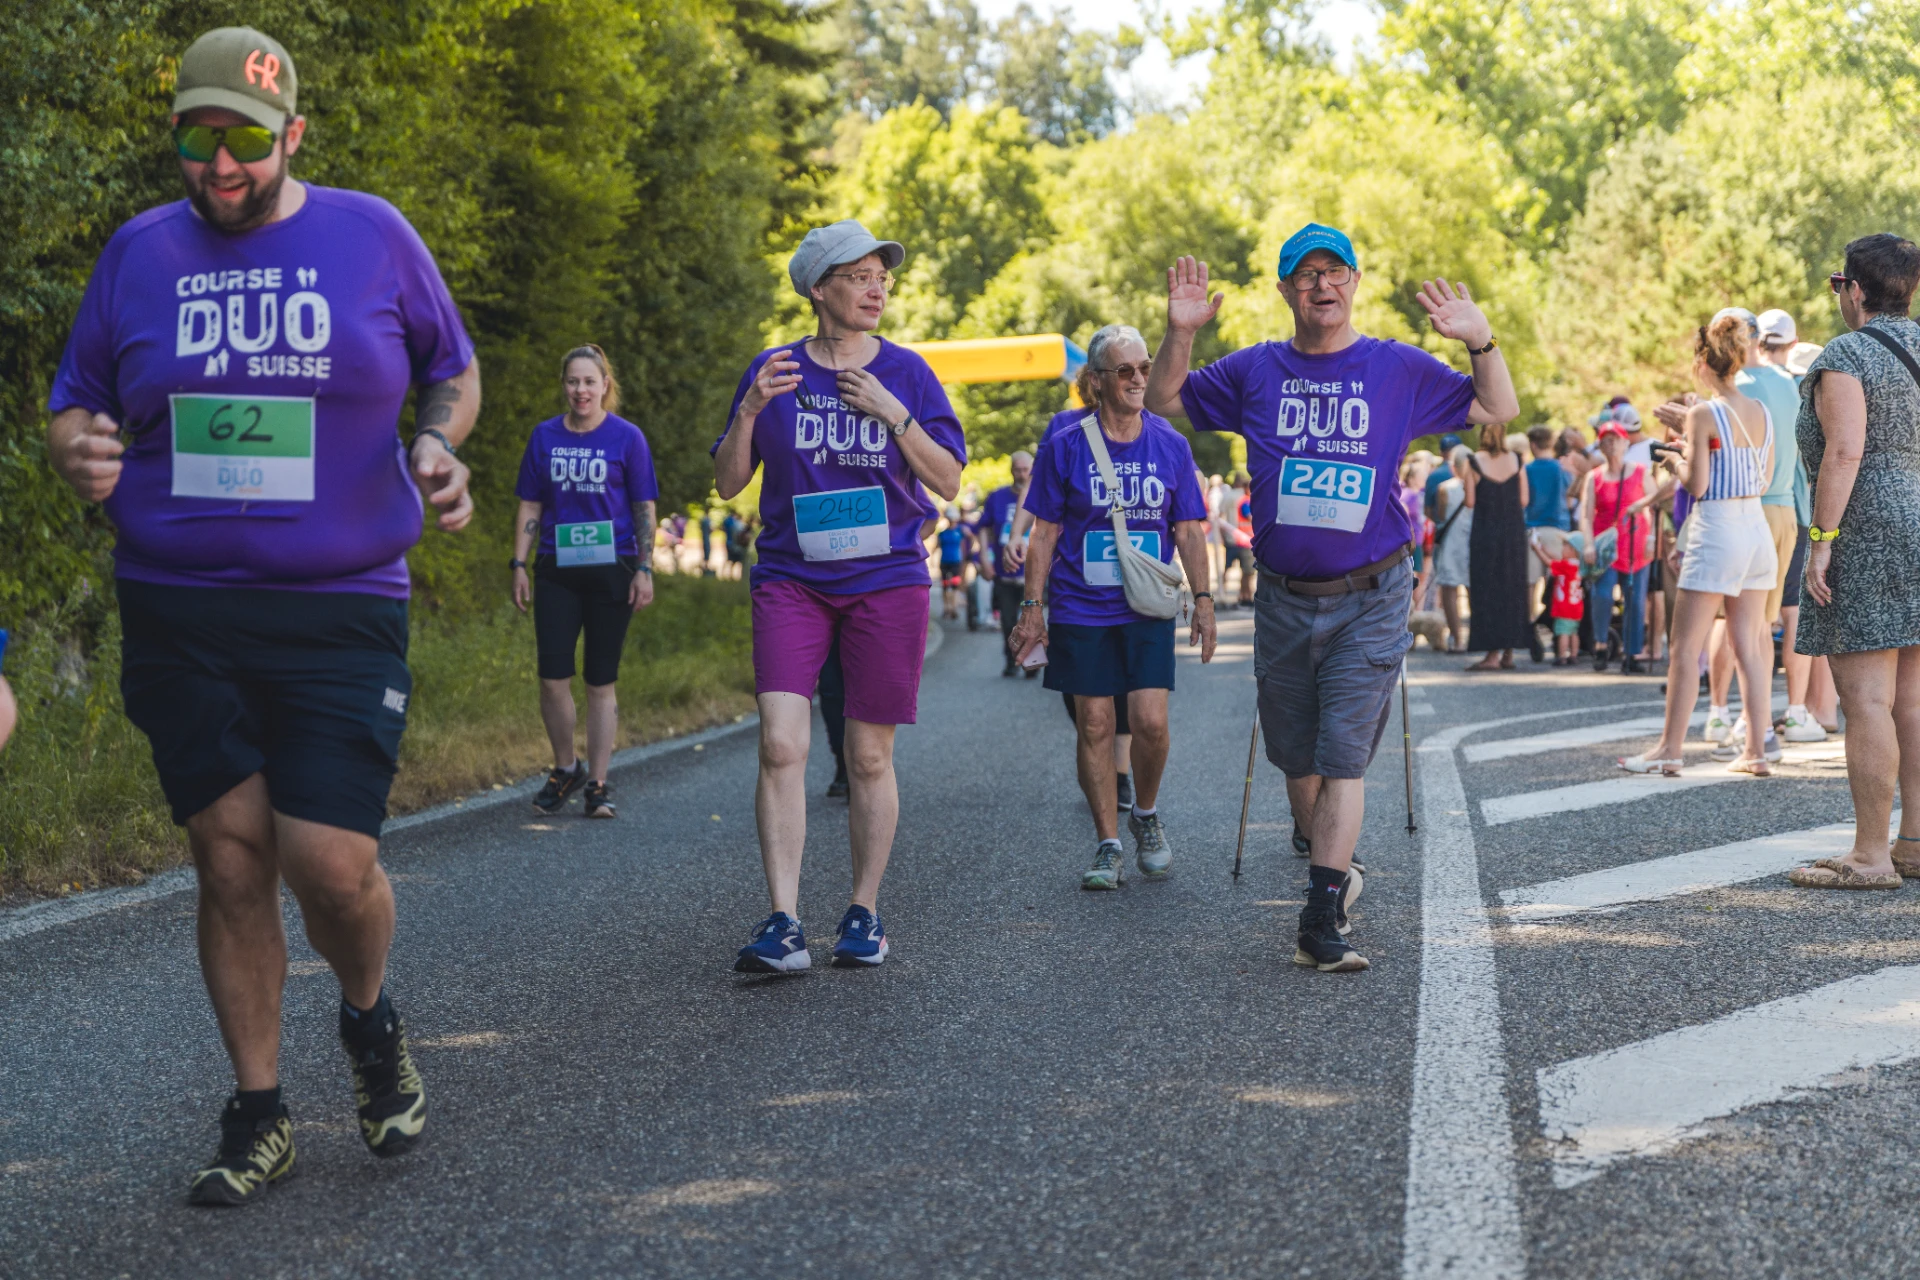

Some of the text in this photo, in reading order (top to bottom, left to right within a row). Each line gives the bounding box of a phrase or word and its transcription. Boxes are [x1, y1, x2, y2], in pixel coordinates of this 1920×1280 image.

[176, 267, 283, 297] COURSE
[176, 291, 332, 357] DUO
[247, 356, 331, 379] SUISSE
[1281, 379, 1343, 395] COURSE
[208, 403, 274, 443] 62
[1276, 397, 1370, 439] DUO
[795, 413, 888, 452] DUO
[551, 447, 592, 457] COURSE
[1317, 440, 1369, 456] SUISSE
[551, 457, 608, 483] DUO
[837, 454, 888, 468] SUISSE
[217, 467, 264, 486] DUO
[1290, 463, 1362, 500] 248
[576, 483, 606, 493] SUISSE
[819, 496, 873, 524] 248
[1126, 508, 1163, 520] SUISSE
[1308, 505, 1338, 519] DUO
[570, 525, 599, 545] 62
[829, 535, 859, 550] DUO
